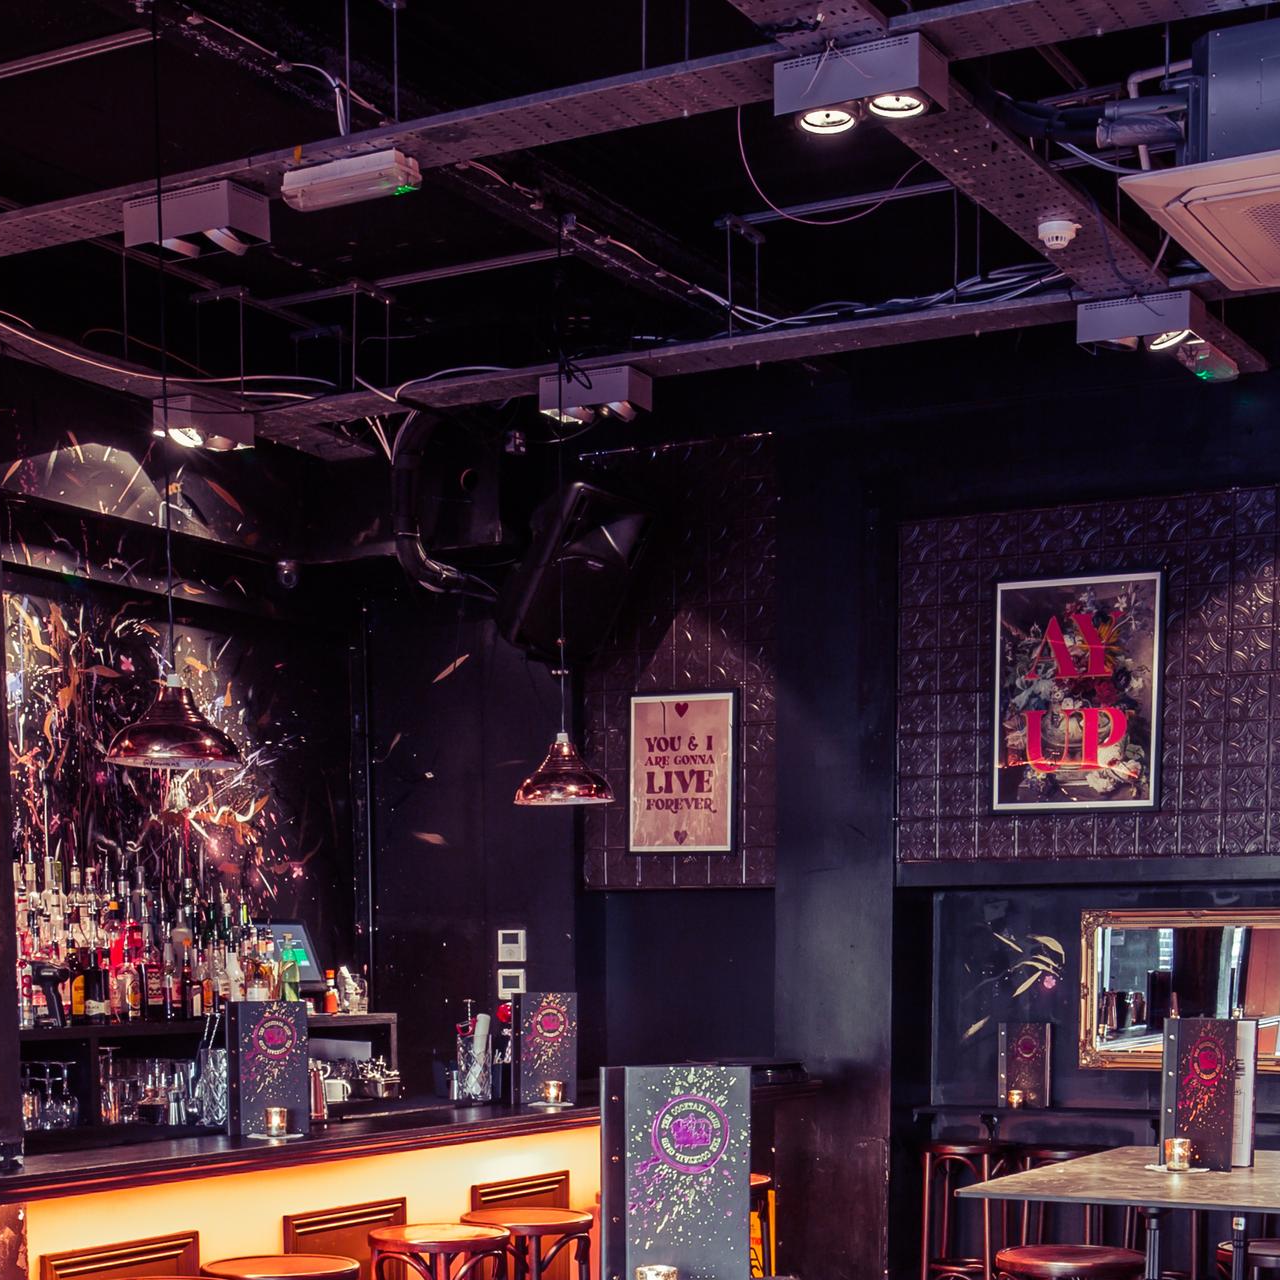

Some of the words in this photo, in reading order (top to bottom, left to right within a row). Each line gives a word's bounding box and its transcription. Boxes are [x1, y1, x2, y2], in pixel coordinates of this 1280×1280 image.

[1024, 610, 1126, 680] AY
[644, 735, 682, 753] YOU
[687, 735, 699, 751] &
[706, 735, 713, 751] I
[1023, 707, 1128, 773] UP
[644, 755, 670, 769] ARE
[673, 754, 716, 766] GONNA
[646, 769, 713, 794] LIVE
[646, 797, 718, 814] FOREVER
[661, 1113, 673, 1129] THE
[671, 1102, 707, 1116] COCKTAIL
[706, 1111, 721, 1129] CLUB
[661, 1137, 676, 1156] CLUB
[675, 1151, 711, 1164] COCKTAIL
